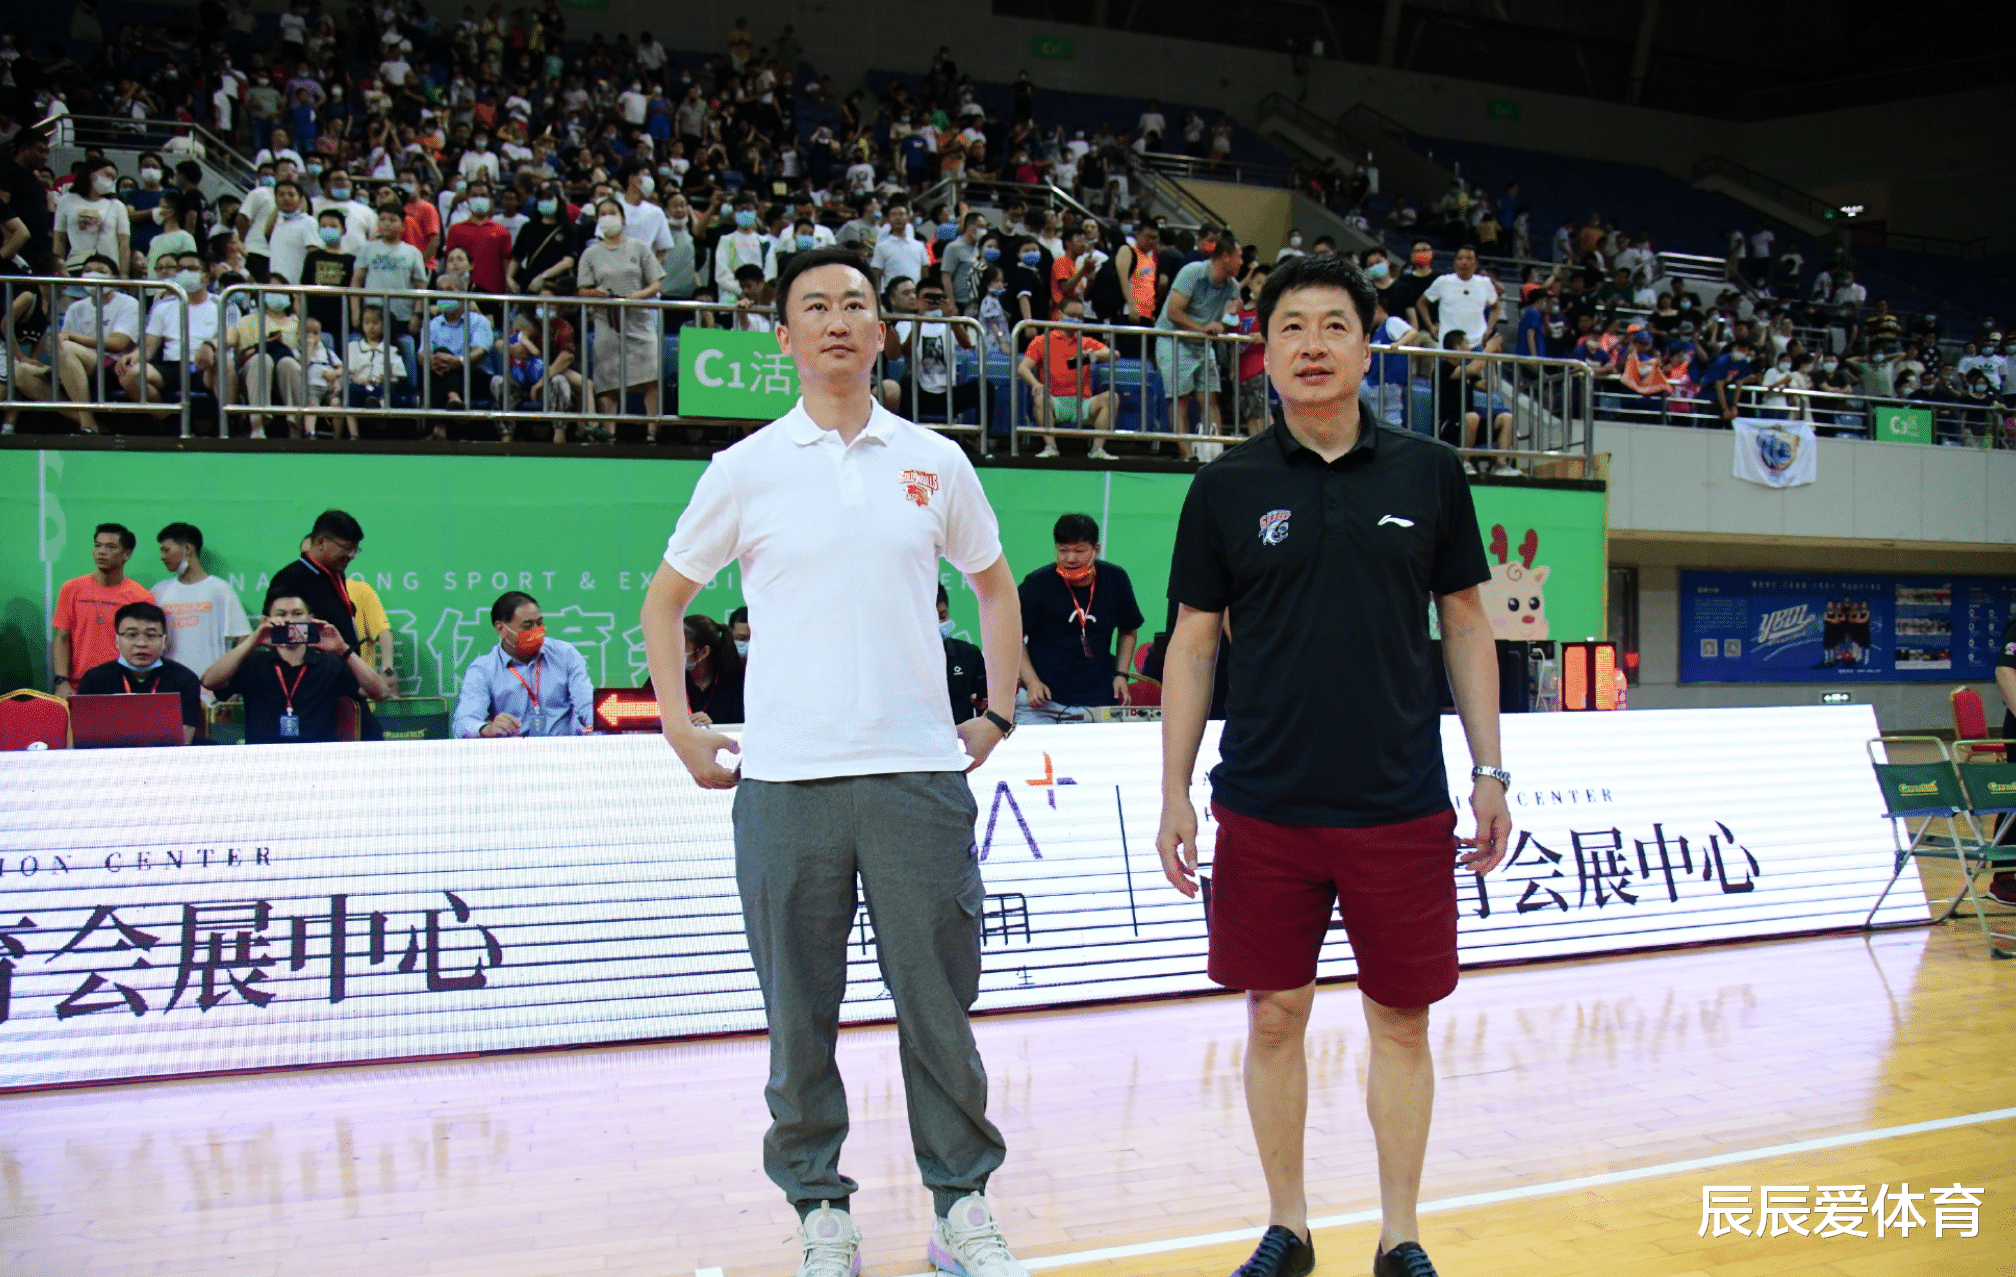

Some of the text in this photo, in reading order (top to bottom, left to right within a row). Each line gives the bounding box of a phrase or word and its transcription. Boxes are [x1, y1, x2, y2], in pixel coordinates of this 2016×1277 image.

[694, 348, 801, 395] C1活
[443, 571, 555, 590] SPORT
[579, 571, 595, 590] &
[1517, 787, 1613, 807] CENTER
[104, 846, 271, 873] CENTER
